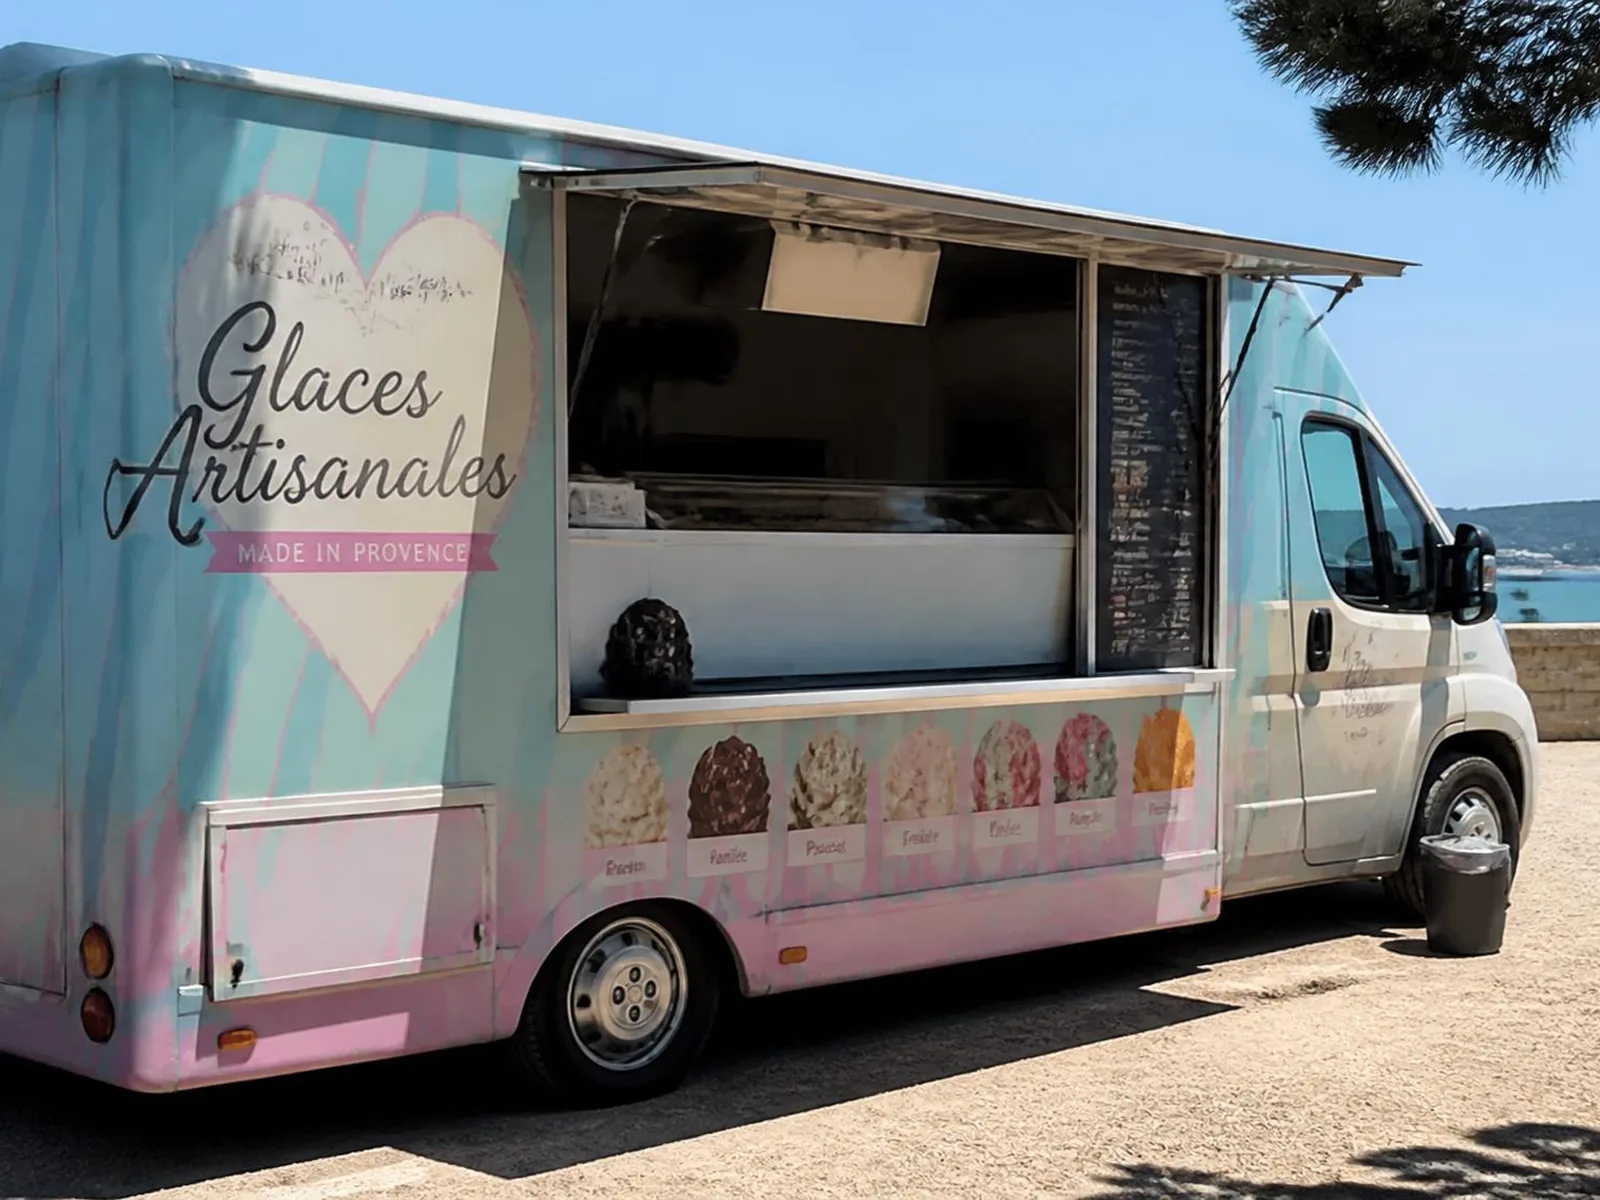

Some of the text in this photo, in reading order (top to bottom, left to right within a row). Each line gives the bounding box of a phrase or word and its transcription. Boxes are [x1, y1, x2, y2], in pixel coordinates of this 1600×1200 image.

[199, 301, 443, 450] Glaces
[103, 403, 517, 546] Artisanales
[237, 542, 467, 563] MADE IN PROVENCE
